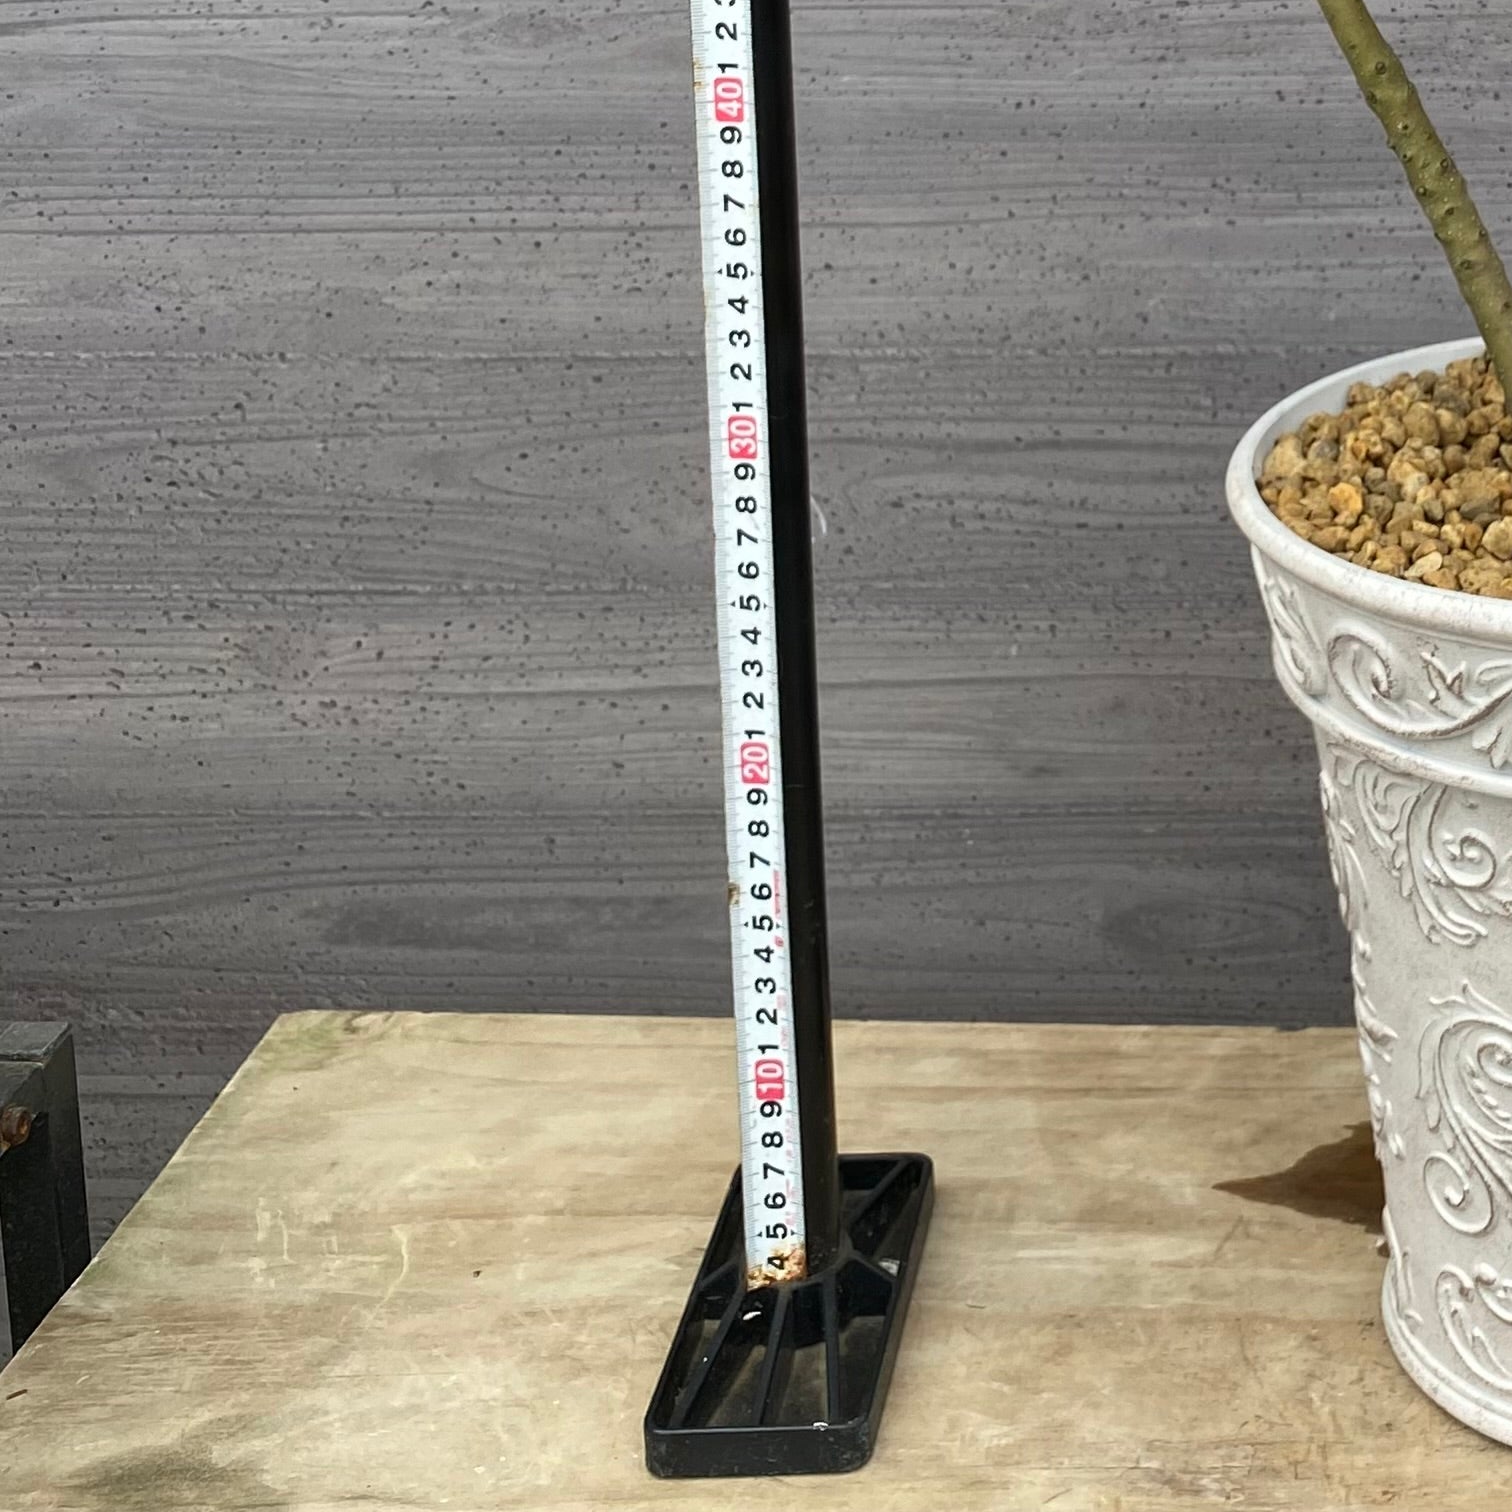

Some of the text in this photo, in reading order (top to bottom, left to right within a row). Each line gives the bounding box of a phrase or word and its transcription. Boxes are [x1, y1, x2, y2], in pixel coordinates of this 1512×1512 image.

[715, 22, 738, 41] 2
[717, 63, 738, 74] 1
[715, 81, 744, 119] 40
[719, 126, 742, 145] 9
[721, 160, 744, 179] 8
[723, 194, 745, 212] 7
[724, 228, 747, 247] 6
[726, 262, 748, 280] 5
[727, 296, 749, 315] 4
[728, 330, 751, 348] 3
[730, 363, 752, 381] 2
[732, 402, 753, 412] 1
[729, 419, 758, 455] 30
[733, 463, 756, 481] 9
[735, 496, 757, 514] 8
[736, 528, 758, 546] 7
[737, 561, 760, 580] 6
[739, 595, 761, 612] 5
[740, 626, 762, 645] 4
[741, 659, 763, 678] 3
[742, 691, 764, 710] 2
[744, 730, 766, 740] 1
[742, 746, 769, 780] 20
[746, 788, 768, 806] 9
[747, 820, 770, 838] 8
[749, 851, 771, 869] 7
[750, 883, 772, 901] 6
[752, 915, 774, 932] 5
[753, 946, 774, 964] 4
[754, 977, 777, 994] 3
[755, 1008, 778, 1026] 2
[757, 1044, 779, 1055] 1
[756, 1061, 784, 1096] 10
[759, 1100, 782, 1118] 9
[761, 1131, 784, 1148] 8
[762, 1162, 785, 1180] 7
[763, 1192, 787, 1210] 6
[765, 1223, 788, 1240] 5
[767, 1253, 790, 1271] 4
